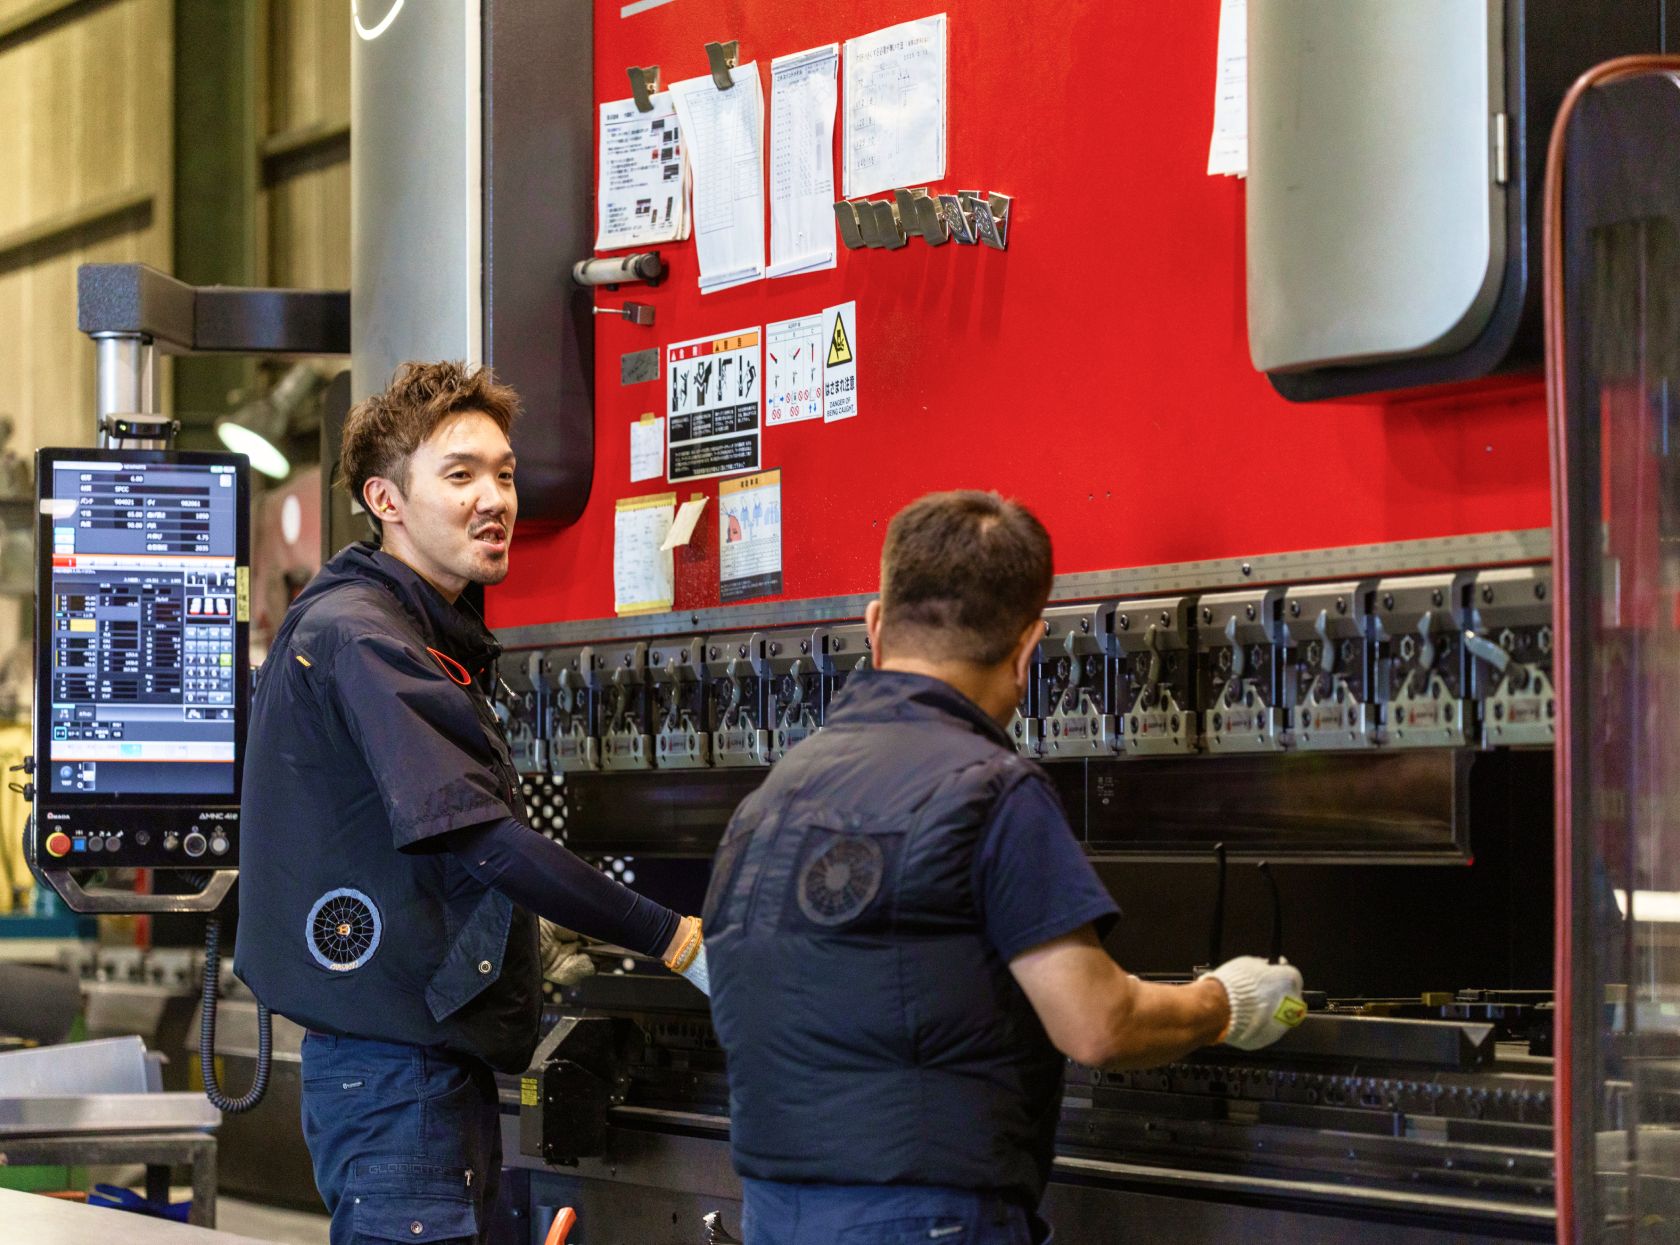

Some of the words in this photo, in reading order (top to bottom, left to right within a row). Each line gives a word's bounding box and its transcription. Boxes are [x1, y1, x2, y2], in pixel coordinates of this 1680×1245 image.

[825, 375, 855, 397] はさまれ注意
[829, 398, 845, 408] DANGER
[846, 396, 851, 404] OF
[827, 407, 838, 417] BEING
[838, 404, 854, 414] CAUGHT
